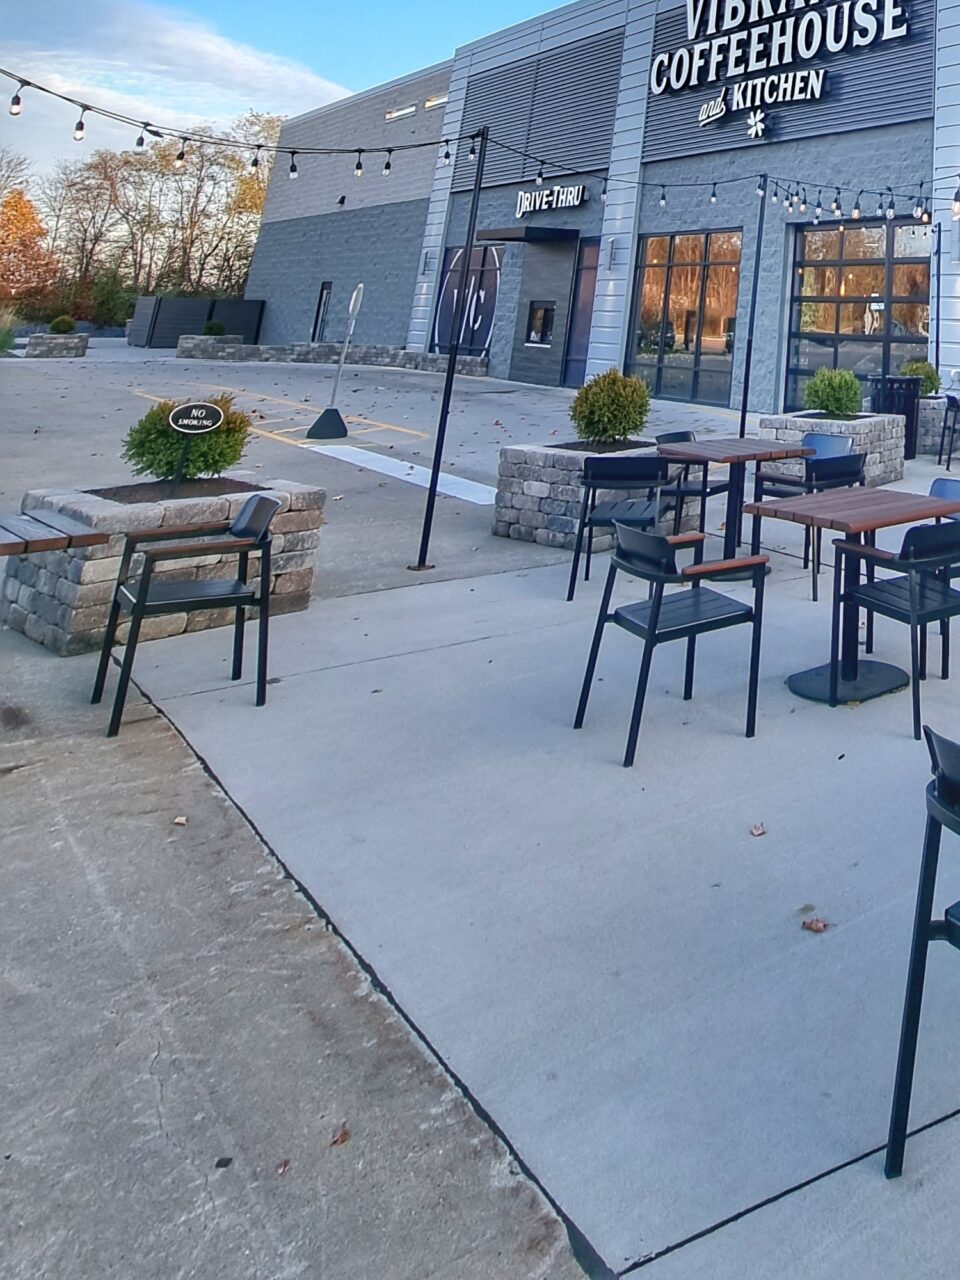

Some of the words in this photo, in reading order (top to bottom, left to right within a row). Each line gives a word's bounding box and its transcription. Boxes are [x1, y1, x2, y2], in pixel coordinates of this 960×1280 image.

[698, 89, 726, 127] and
[731, 70, 826, 111] KITCHEN
[190, 408, 205, 417] NO
[178, 418, 212, 426] SMOKING
